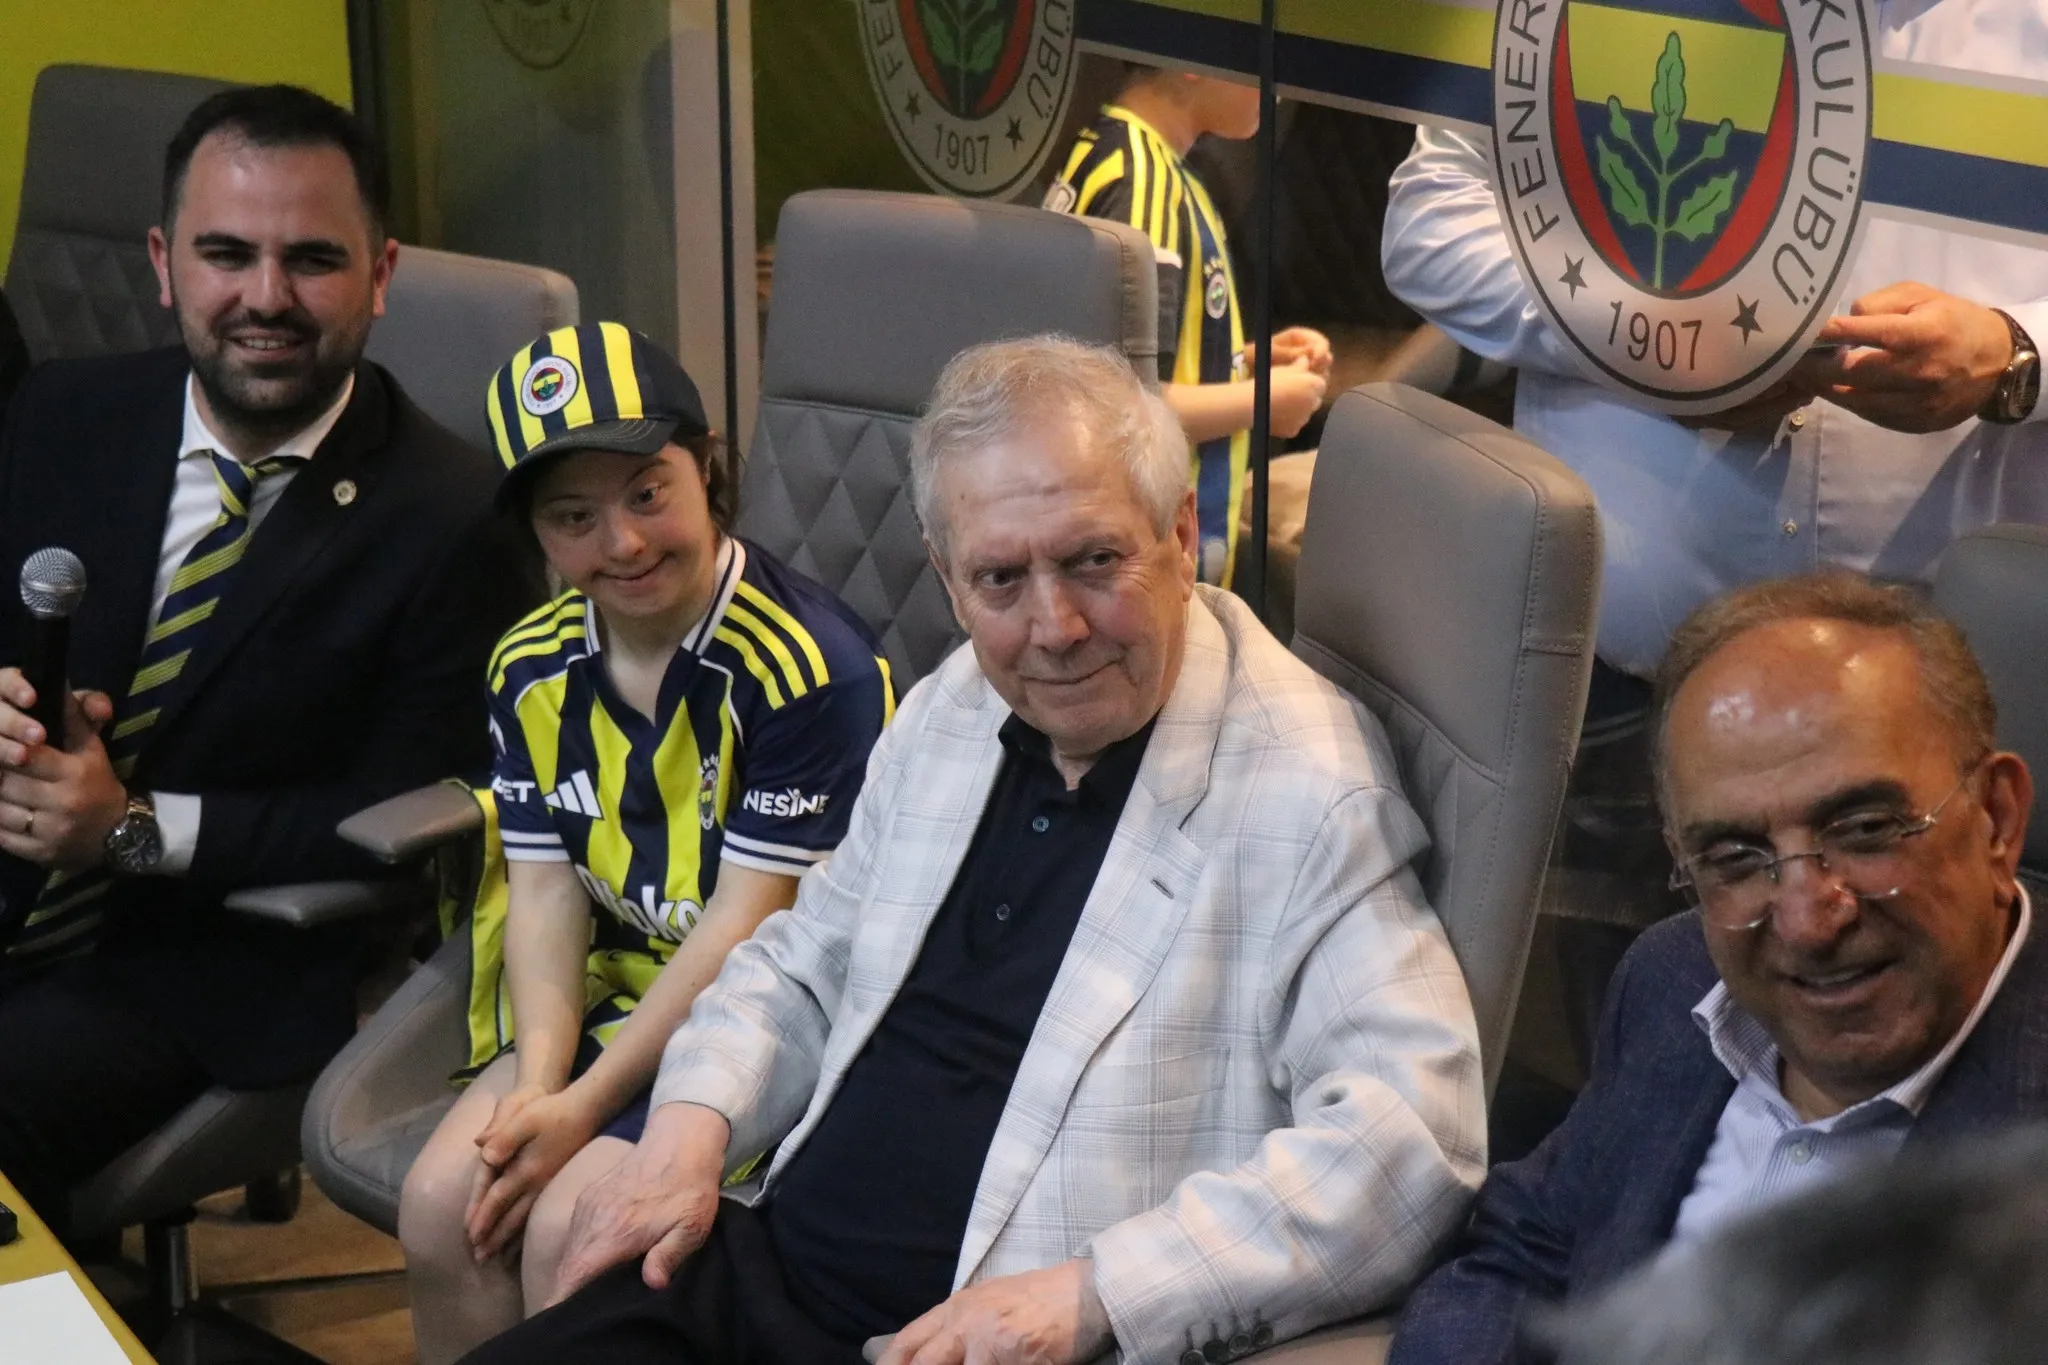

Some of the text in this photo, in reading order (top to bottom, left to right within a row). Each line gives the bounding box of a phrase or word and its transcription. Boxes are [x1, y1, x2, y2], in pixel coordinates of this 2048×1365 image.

[873, 0, 903, 81] FE
[935, 123, 990, 175] 1907
[1607, 300, 1703, 371] 1907
